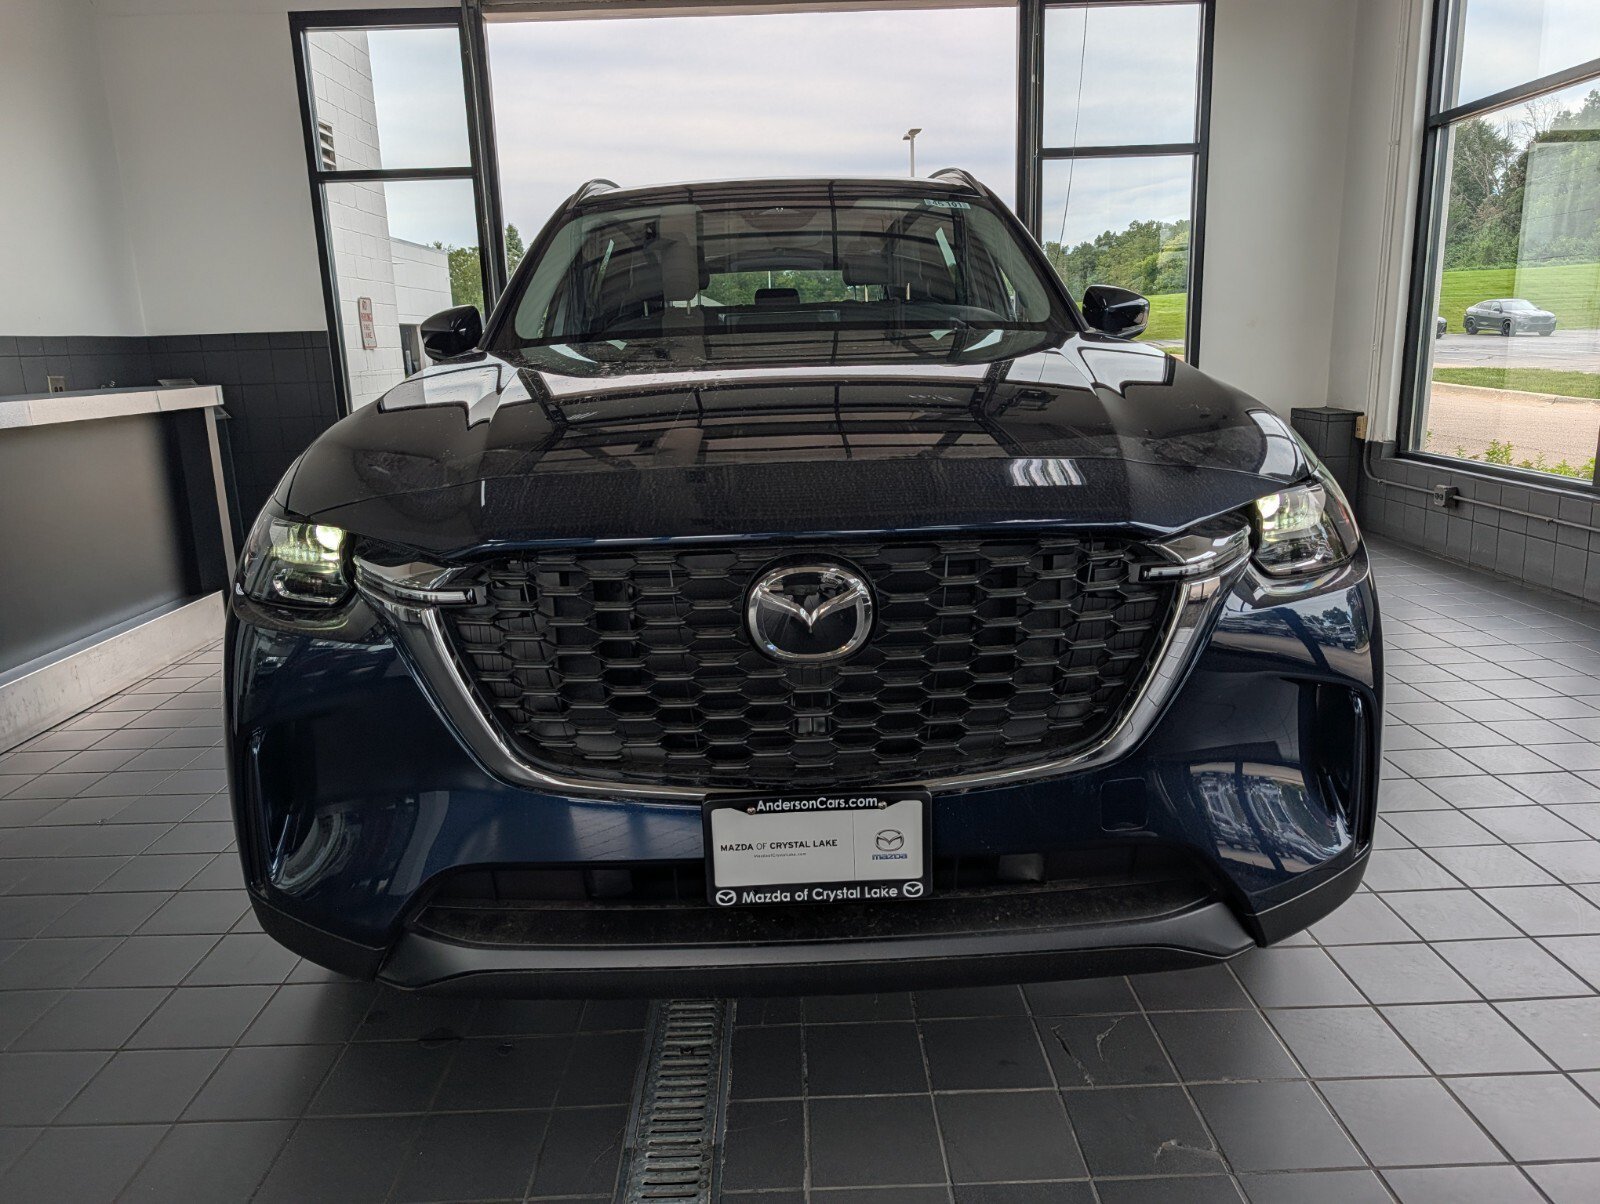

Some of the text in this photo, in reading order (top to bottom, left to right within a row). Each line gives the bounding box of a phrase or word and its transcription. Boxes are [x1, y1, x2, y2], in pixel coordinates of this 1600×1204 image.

[756, 796, 878, 812] AndersonCars.com
[720, 839, 838, 852] MAZDA OF CRYSTAL LAKE
[871, 852, 908, 861] mazda
[742, 886, 898, 904] Mazda of Crystal Lake
